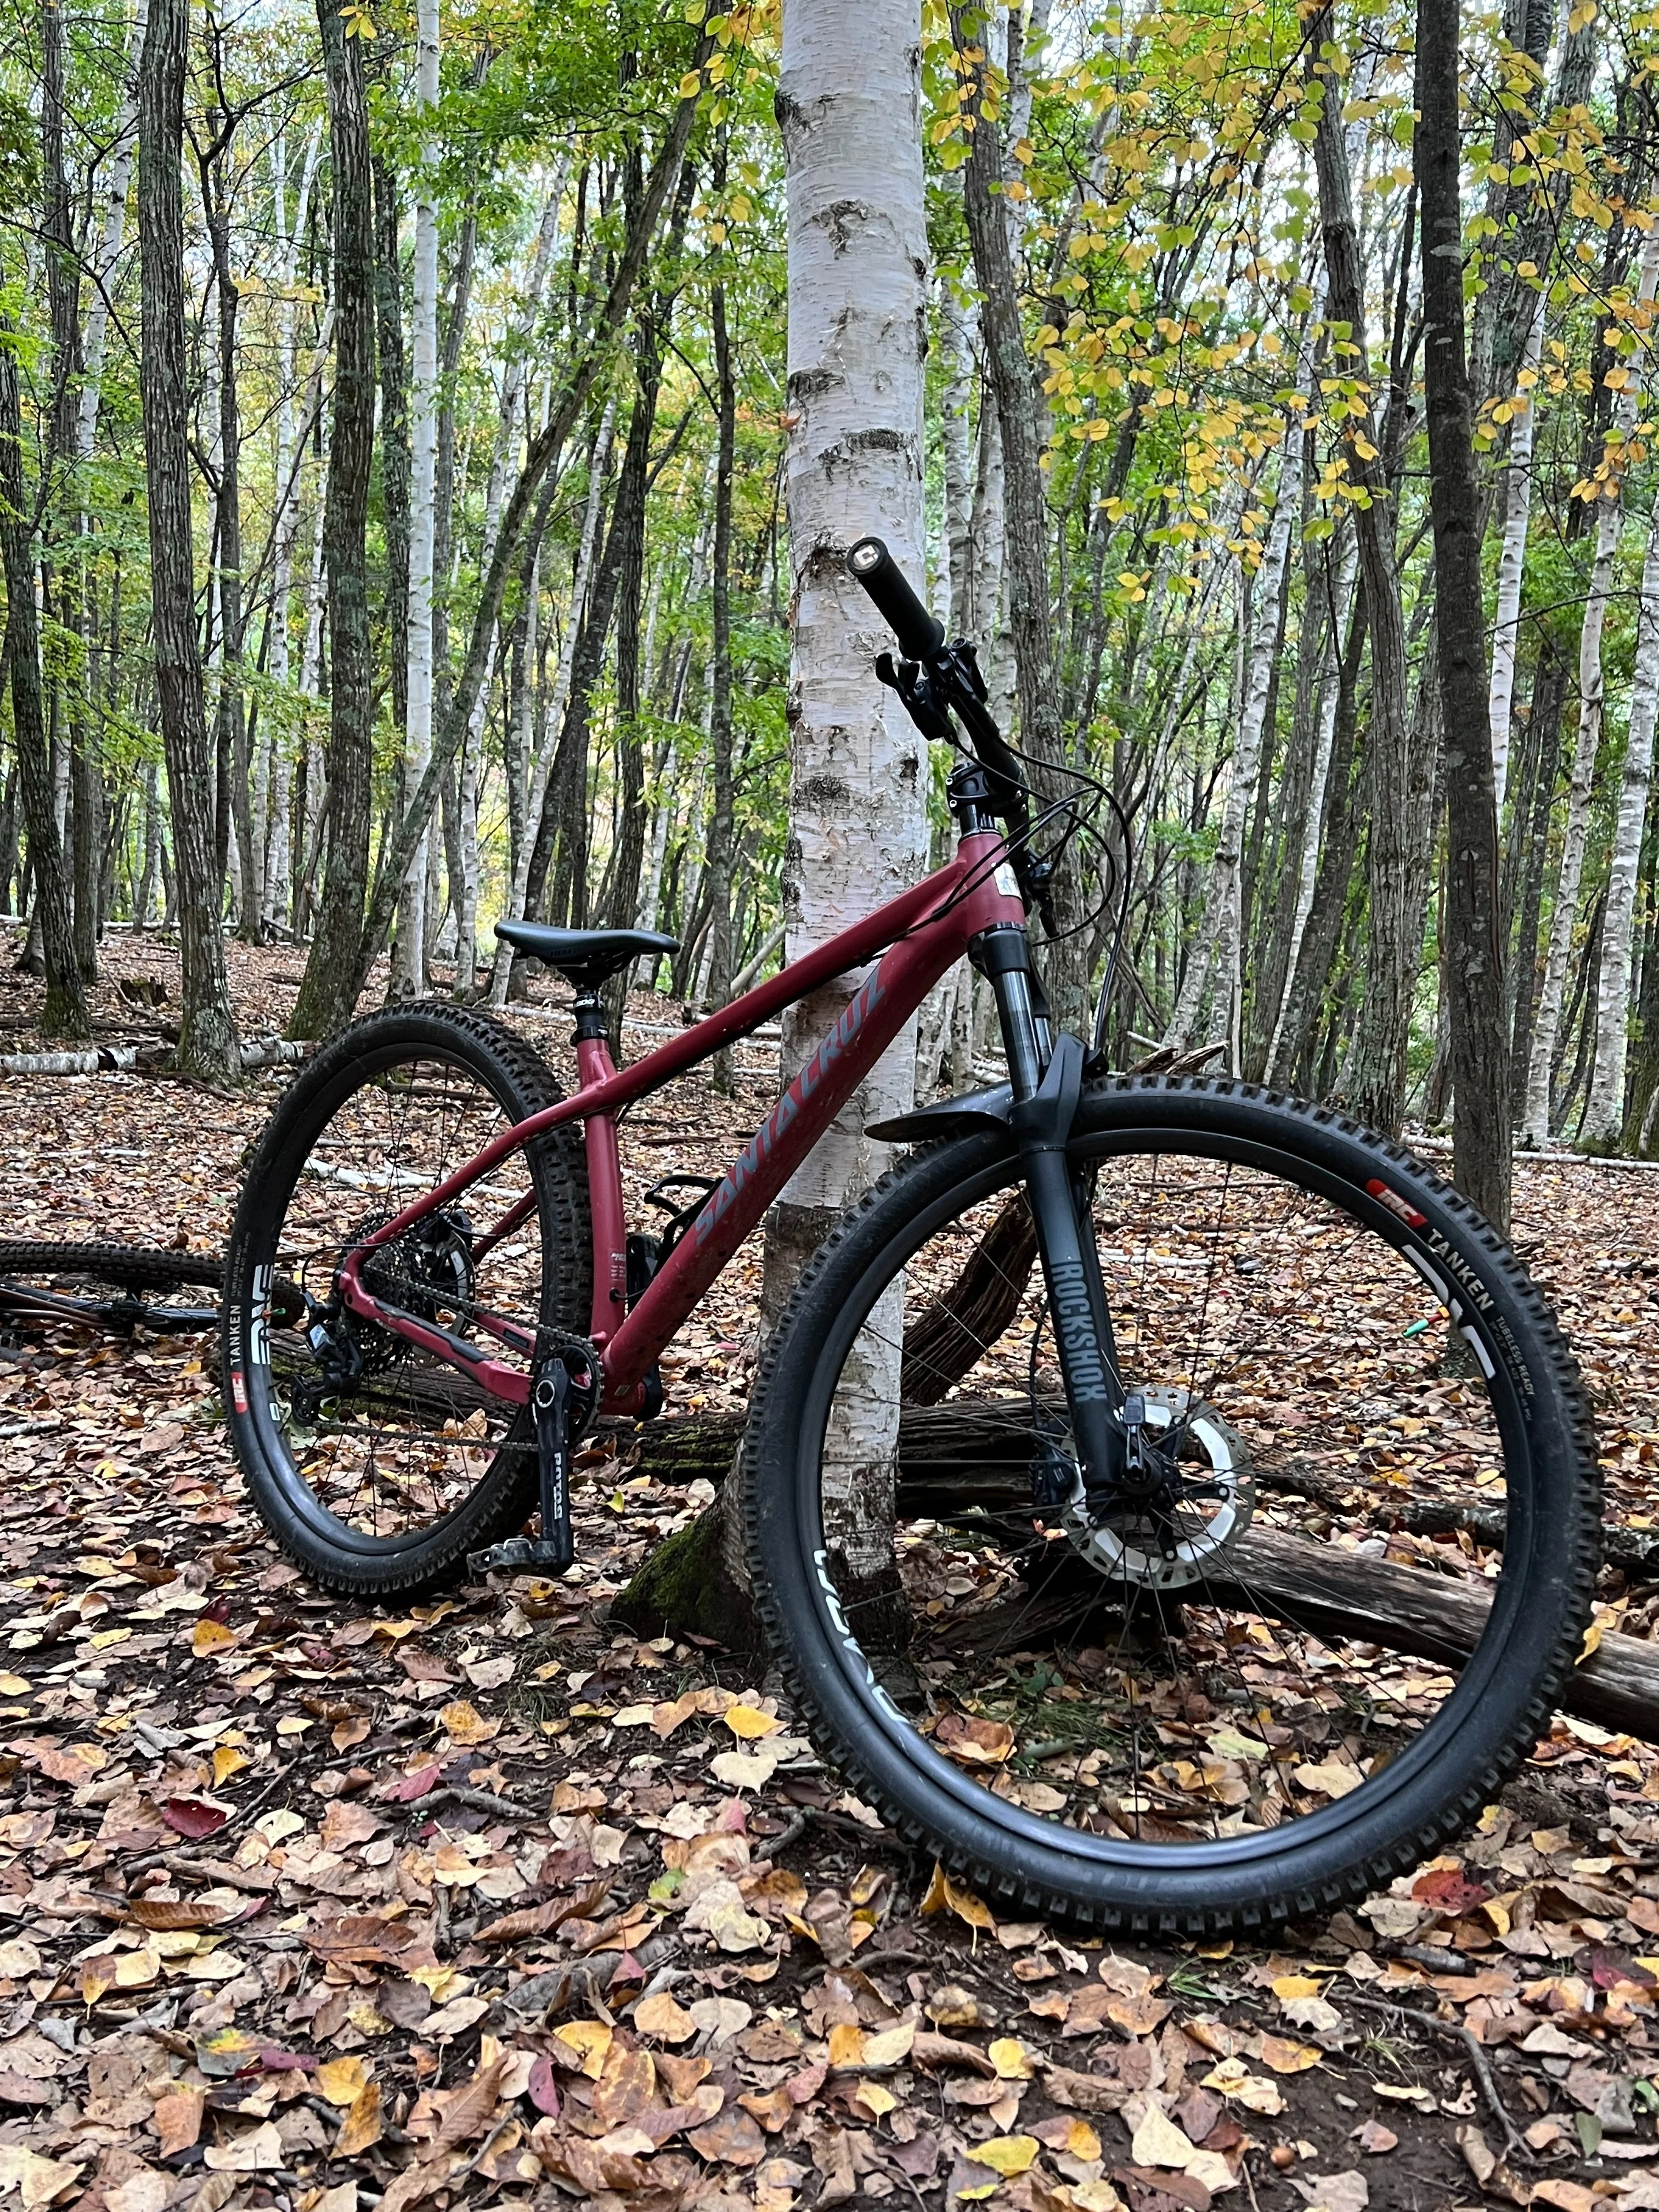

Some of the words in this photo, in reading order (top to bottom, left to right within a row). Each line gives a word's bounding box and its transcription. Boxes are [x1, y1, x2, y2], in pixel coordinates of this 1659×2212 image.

[695, 1090, 799, 1245] SANTA
[800, 966, 885, 1098] CRUZ
[1427, 1228, 1496, 1311] TANKEN
[229, 1305, 241, 1366] TANKEN
[1051, 1262, 1108, 1403] ROCKSHOX
[1496, 1316, 1523, 1364] TUBELESS
[1518, 1364, 1535, 1395] READY
